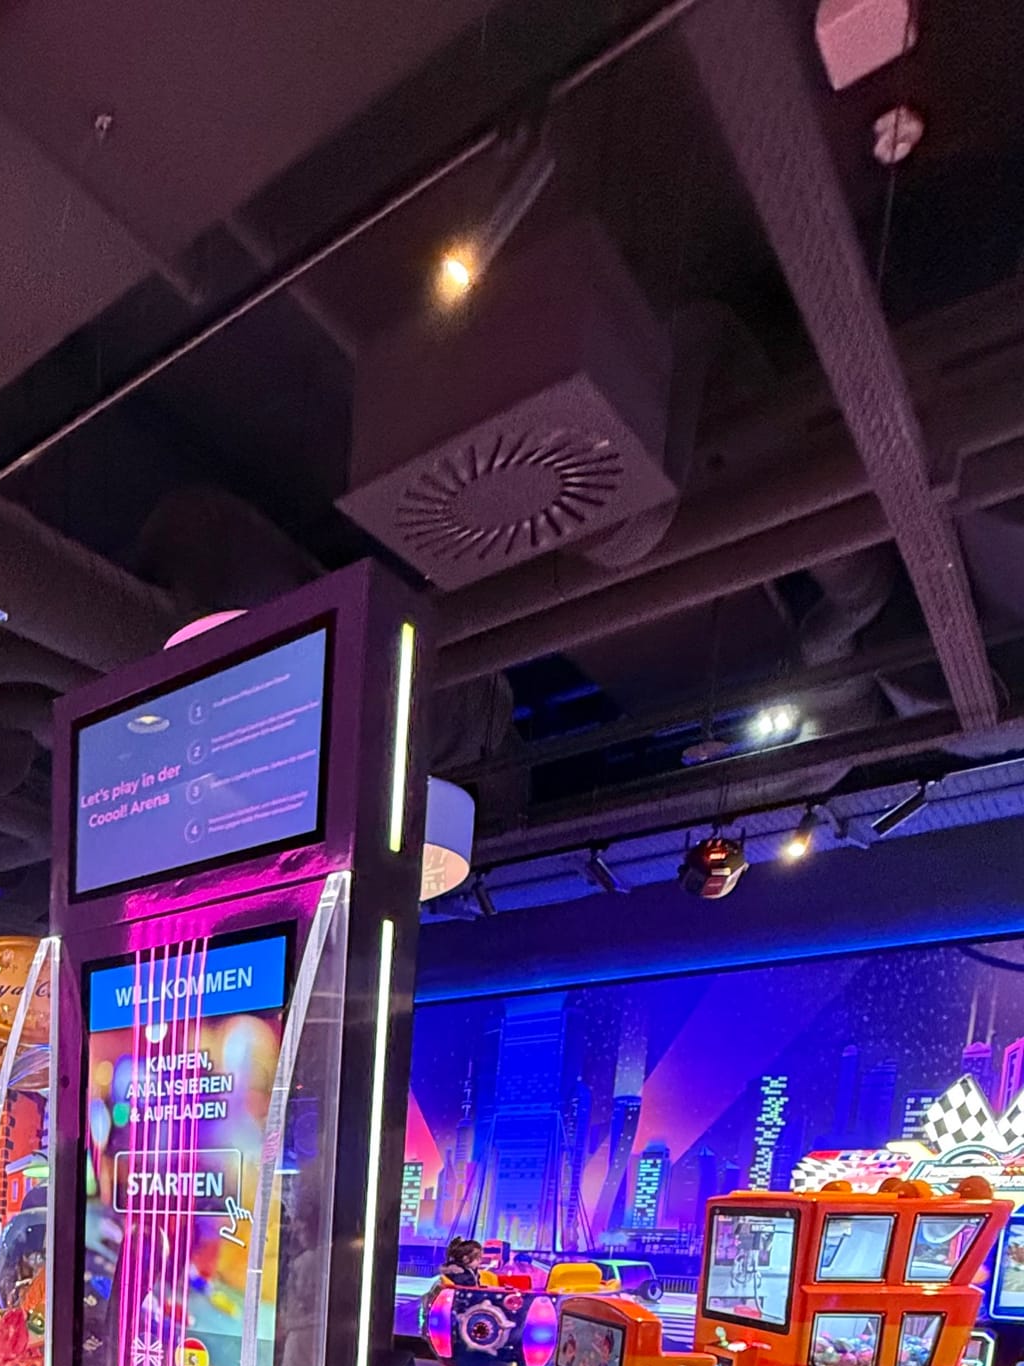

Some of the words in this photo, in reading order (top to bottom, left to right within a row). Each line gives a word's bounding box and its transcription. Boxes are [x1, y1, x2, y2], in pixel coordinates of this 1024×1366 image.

[195, 706, 202, 718] 1
[193, 746, 201, 758] 2
[80, 788, 110, 808] Let's
[112, 778, 140, 800] play
[141, 773, 155, 787] in
[158, 764, 181, 782] der
[192, 786, 200, 798] 3
[89, 804, 128, 828] Coool!
[130, 793, 170, 815] Arena
[191, 824, 198, 836] 4
[115, 966, 253, 1008] WILLKOMMEN
[146, 1051, 213, 1073] KAUFEN,
[126, 1074, 233, 1099] ANALYSIEREN
[129, 1107, 141, 1122] &
[144, 1101, 226, 1122] AUFLADEN
[127, 1172, 224, 1197] STARTEN
